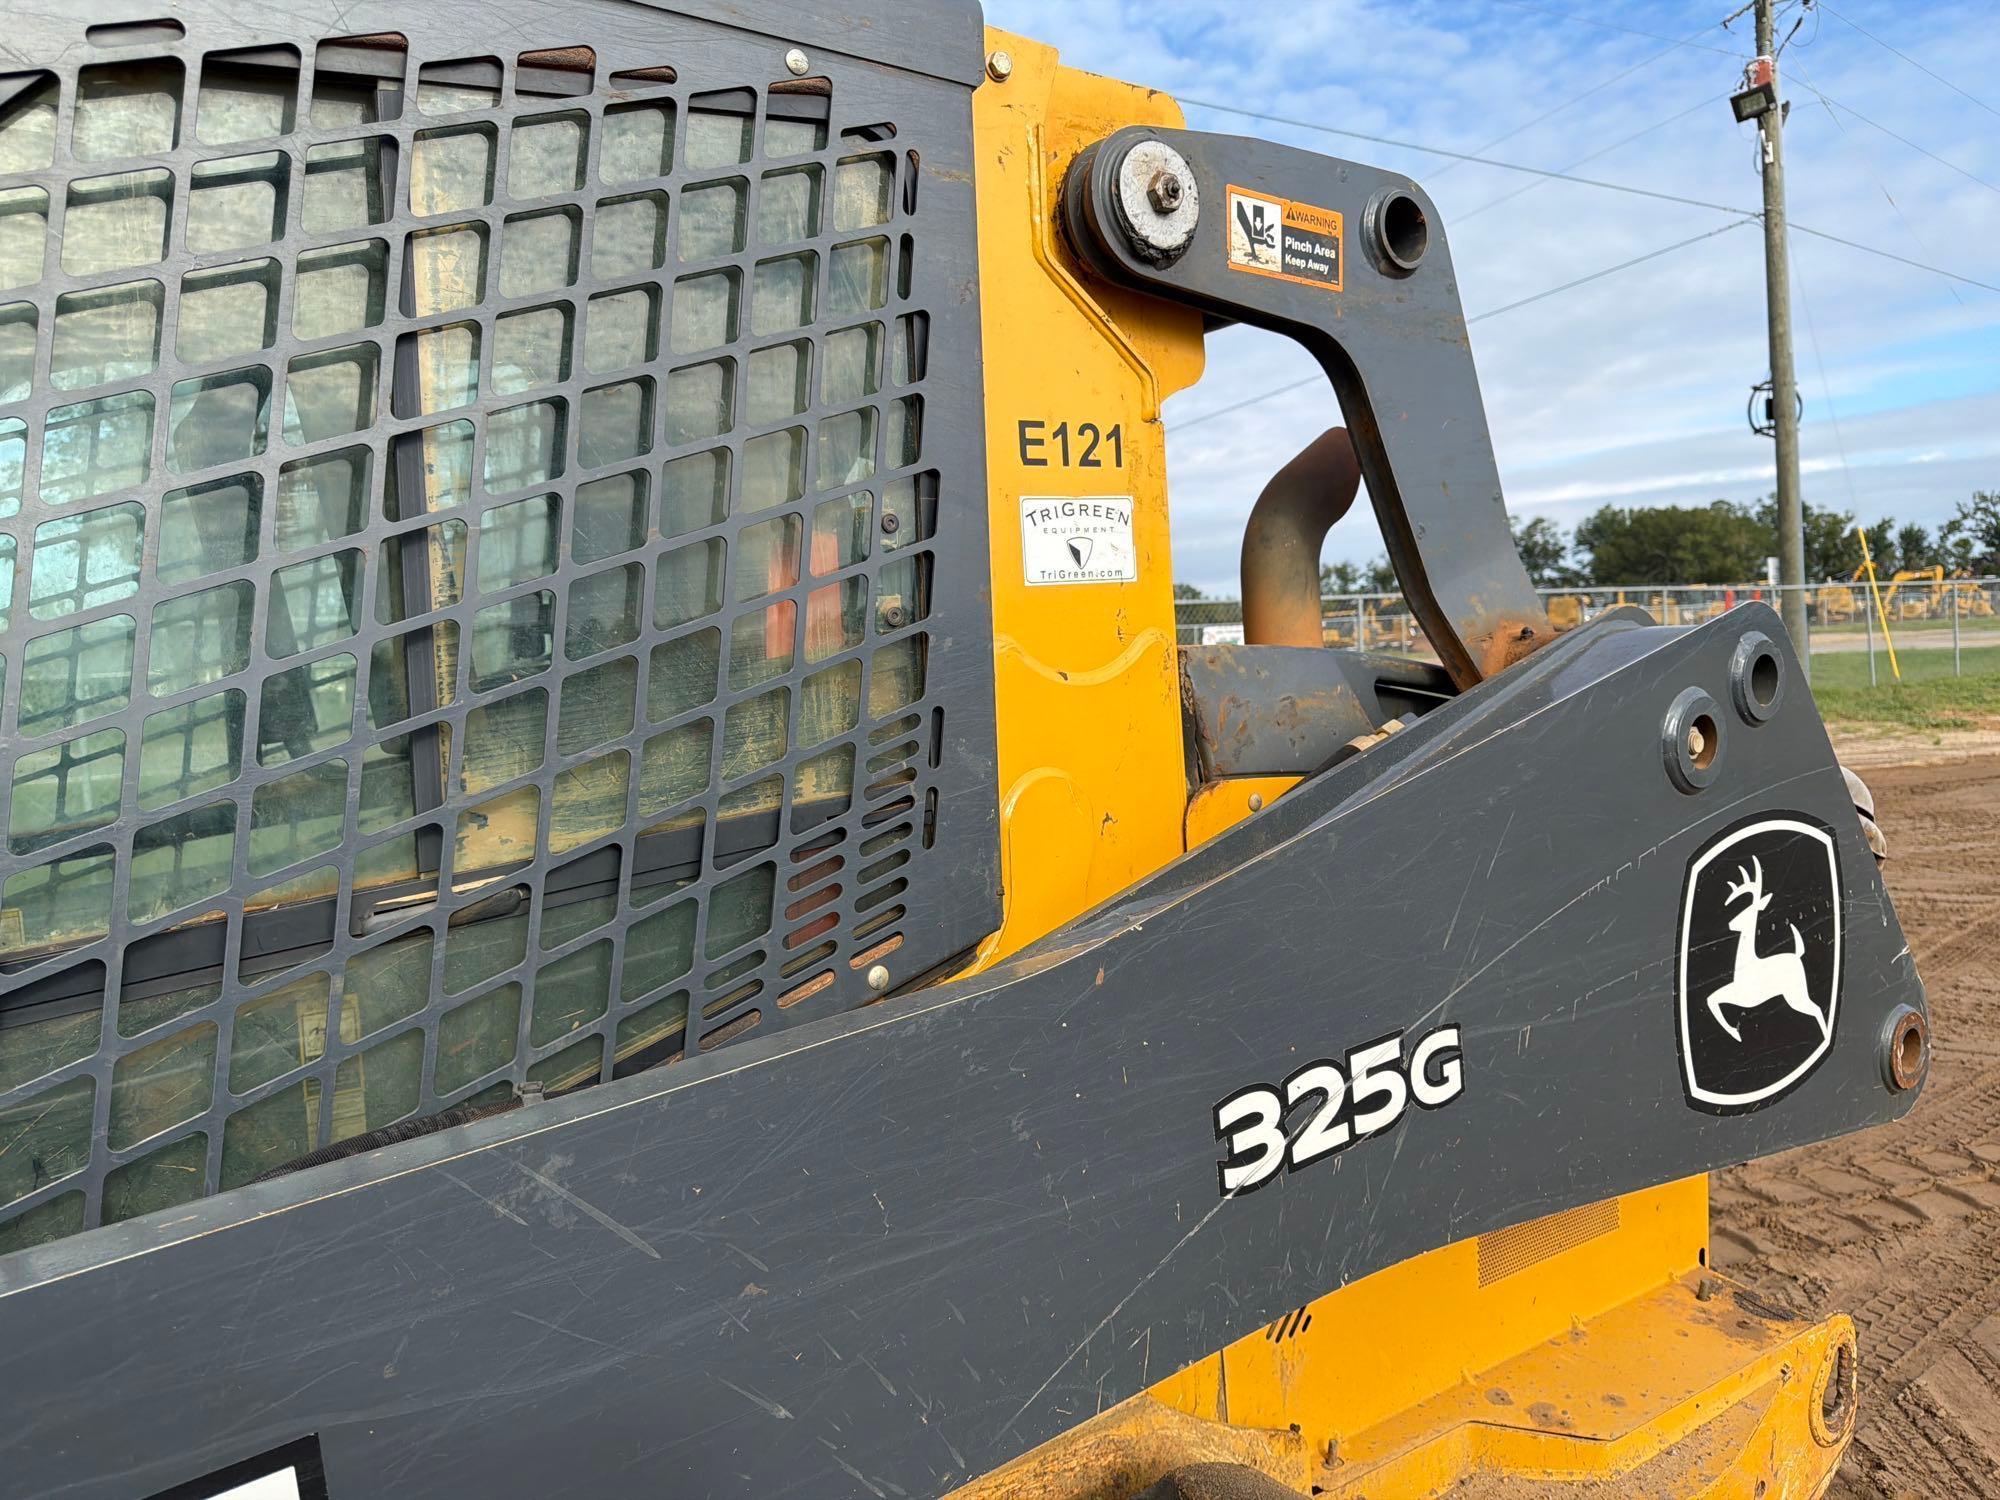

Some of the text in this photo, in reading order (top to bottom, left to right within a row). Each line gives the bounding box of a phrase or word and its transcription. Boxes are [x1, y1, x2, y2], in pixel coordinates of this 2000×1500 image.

[1296, 211, 1337, 231] WARNING
[1285, 236, 1336, 259] Pinch Area
[1285, 254, 1329, 274] Keep Away
[1018, 420, 1123, 468] E121
[1025, 502, 1130, 527] TRIGREEN
[1043, 526, 1115, 534] EQUIPMENT
[1040, 569, 1123, 580] TriGreen.com
[1216, 1026, 1463, 1194] 325G
